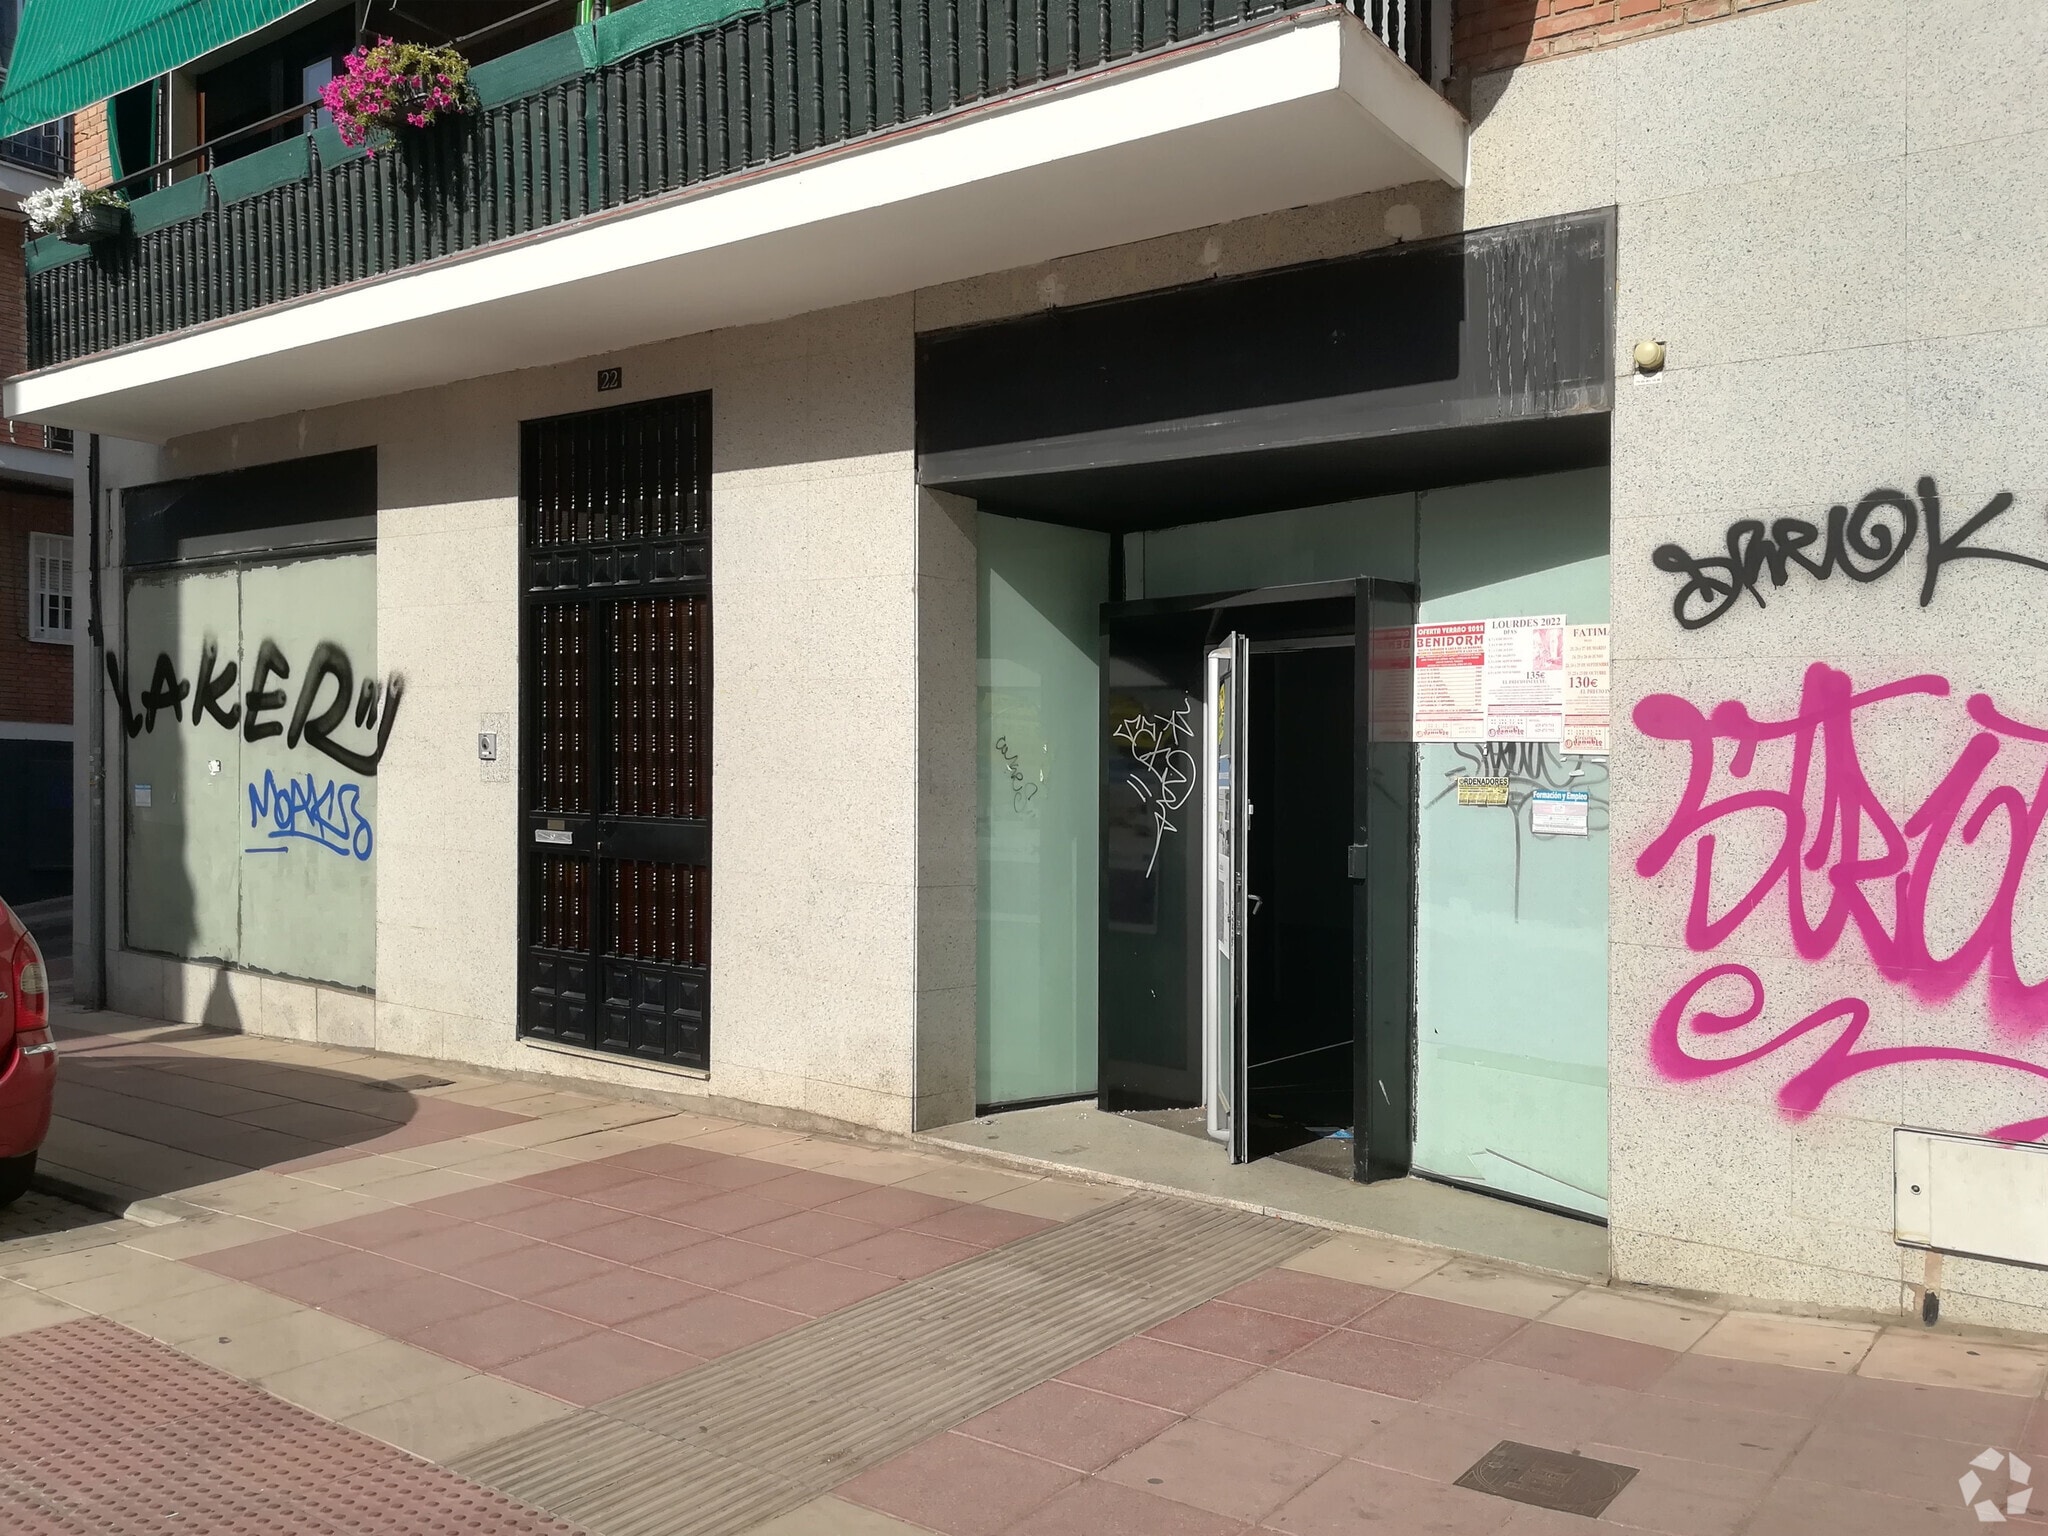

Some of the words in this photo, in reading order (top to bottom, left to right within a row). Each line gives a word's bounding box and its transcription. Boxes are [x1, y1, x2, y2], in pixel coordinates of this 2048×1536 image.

[601, 370, 618, 389] 22
[1492, 619, 1539, 629] LOURDES
[1540, 617, 1561, 626] 2022
[1441, 626, 1467, 634] VERANO
[1417, 635, 1483, 647] BENIDORM
[1526, 671, 1546, 680] 135€
[1569, 676, 1599, 688] 130€
[1459, 777, 1508, 786] ORDENADORES
[1533, 790, 1562, 799] Formación
[1561, 793, 1566, 801] y
[1566, 792, 1588, 802] Empleo
